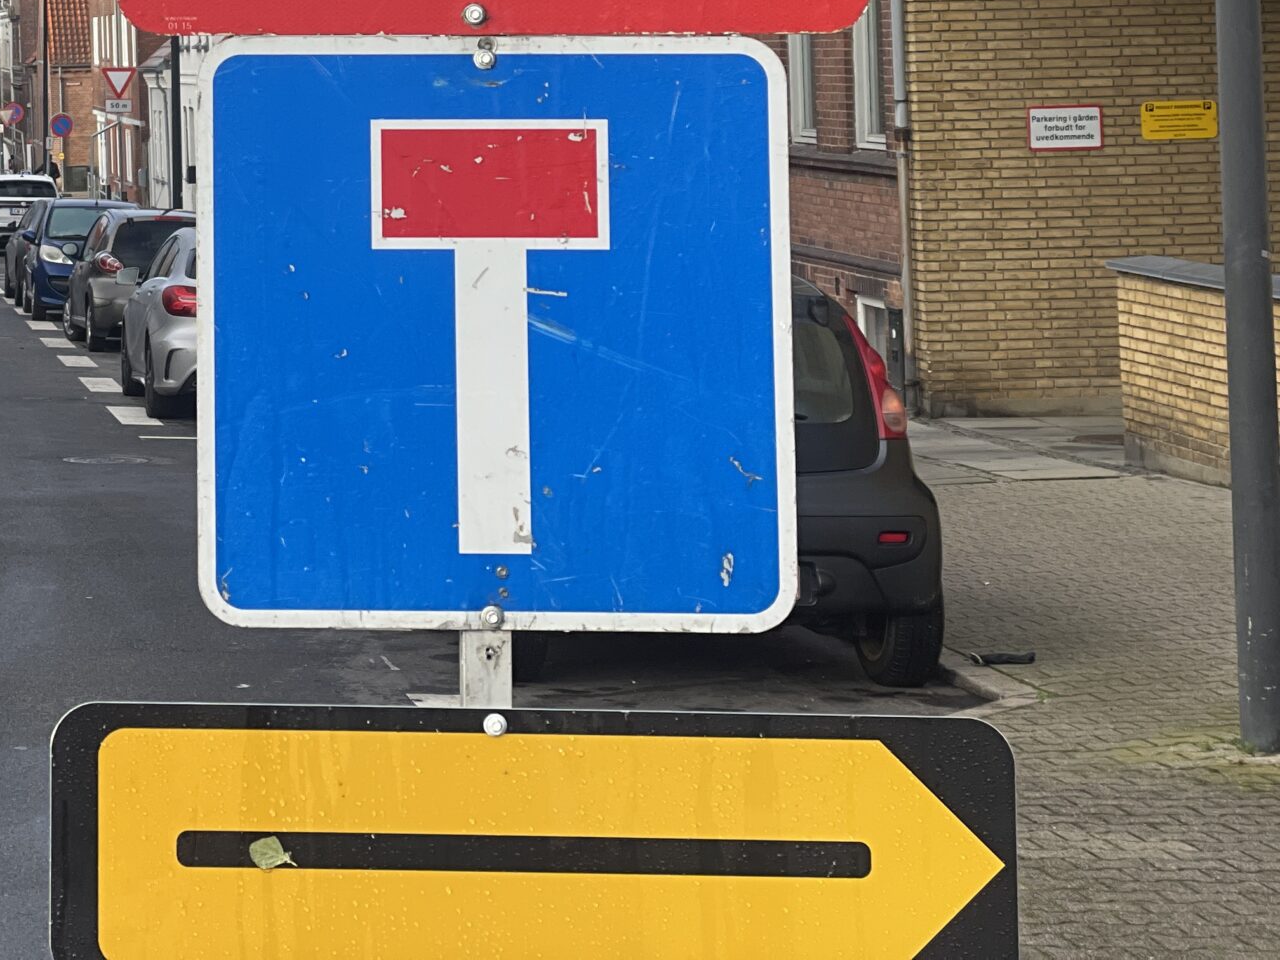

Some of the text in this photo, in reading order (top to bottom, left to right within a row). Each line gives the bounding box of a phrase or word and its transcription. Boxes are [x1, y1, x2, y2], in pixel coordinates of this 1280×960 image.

[1032, 115, 1067, 123] Parkering
[1073, 114, 1099, 123] gården
[1036, 133, 1095, 141] uvedkommende
